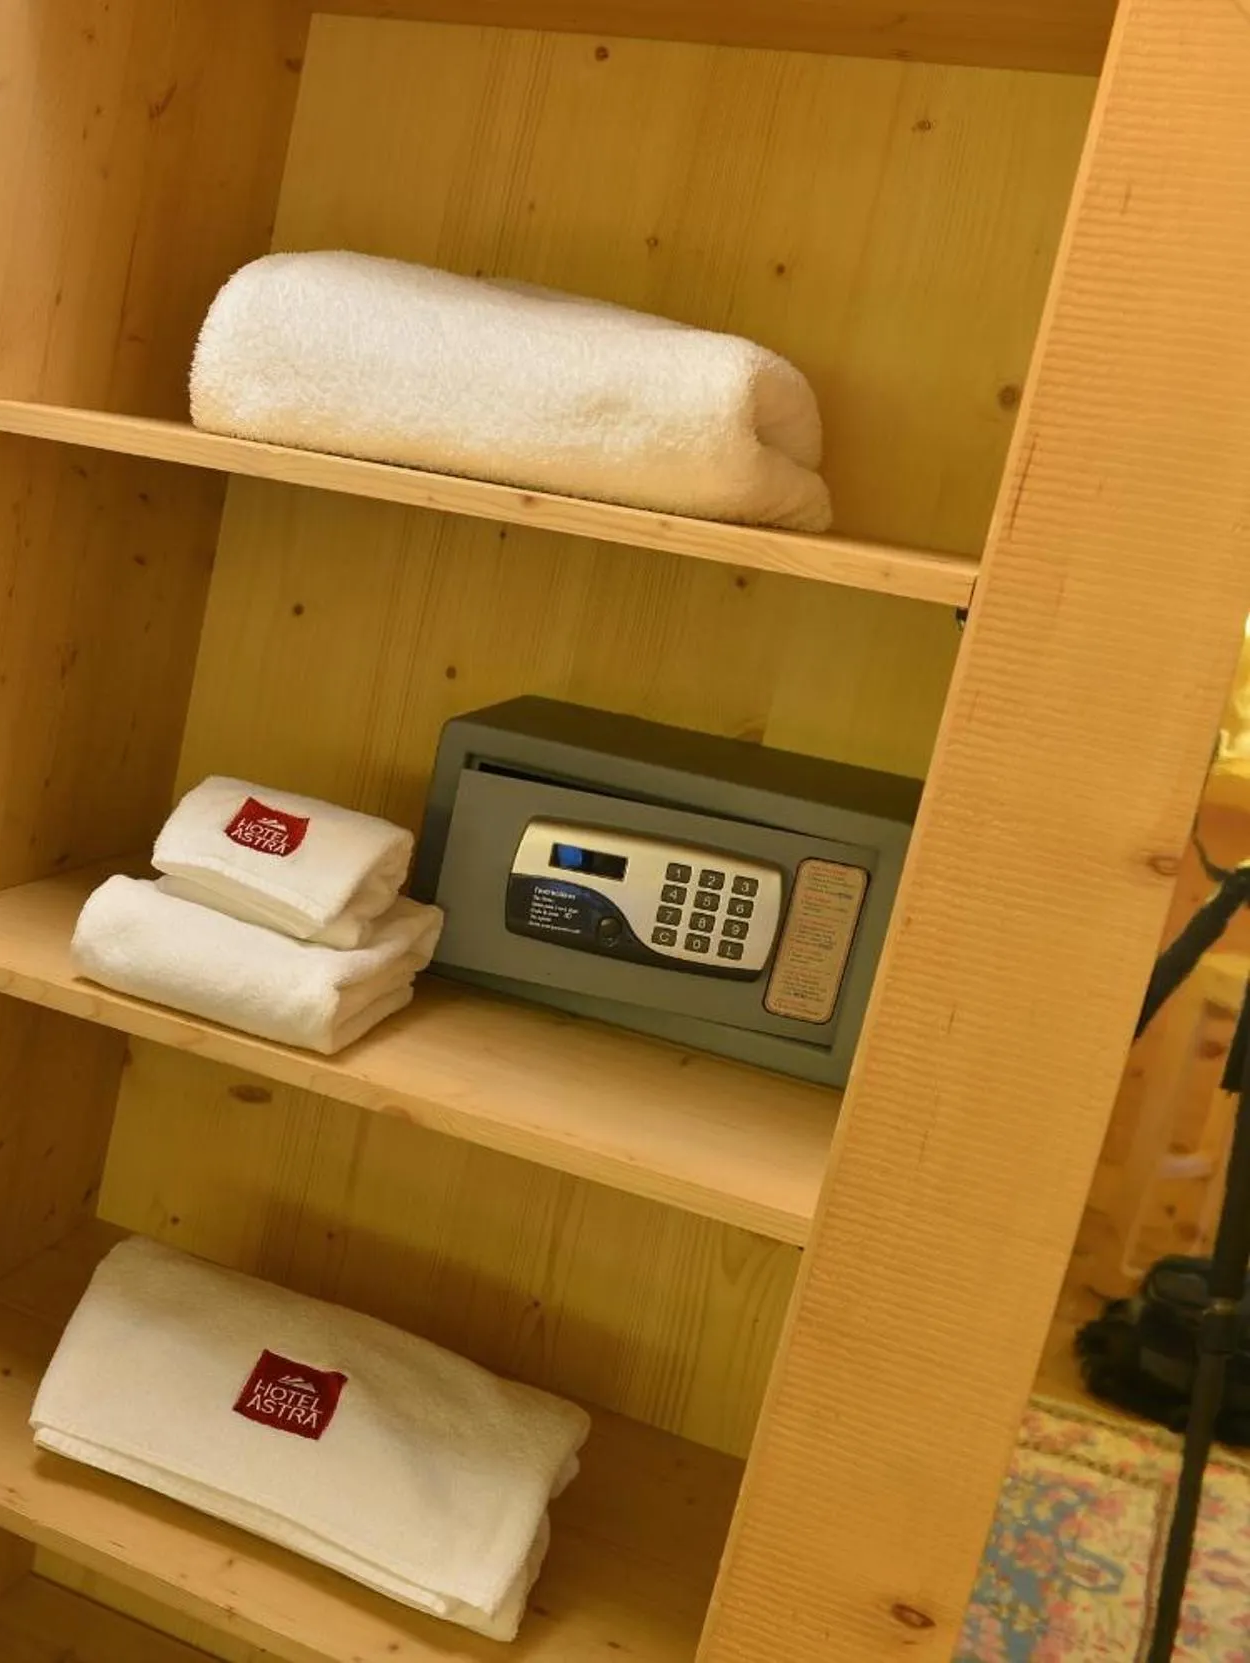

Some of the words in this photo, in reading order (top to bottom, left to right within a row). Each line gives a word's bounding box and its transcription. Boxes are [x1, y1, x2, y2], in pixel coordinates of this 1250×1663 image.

[231, 828, 287, 854] ASTRA
[237, 818, 290, 846] HOTEL
[246, 1394, 319, 1429] ASTRA
[253, 1378, 324, 1414] HOTEL
